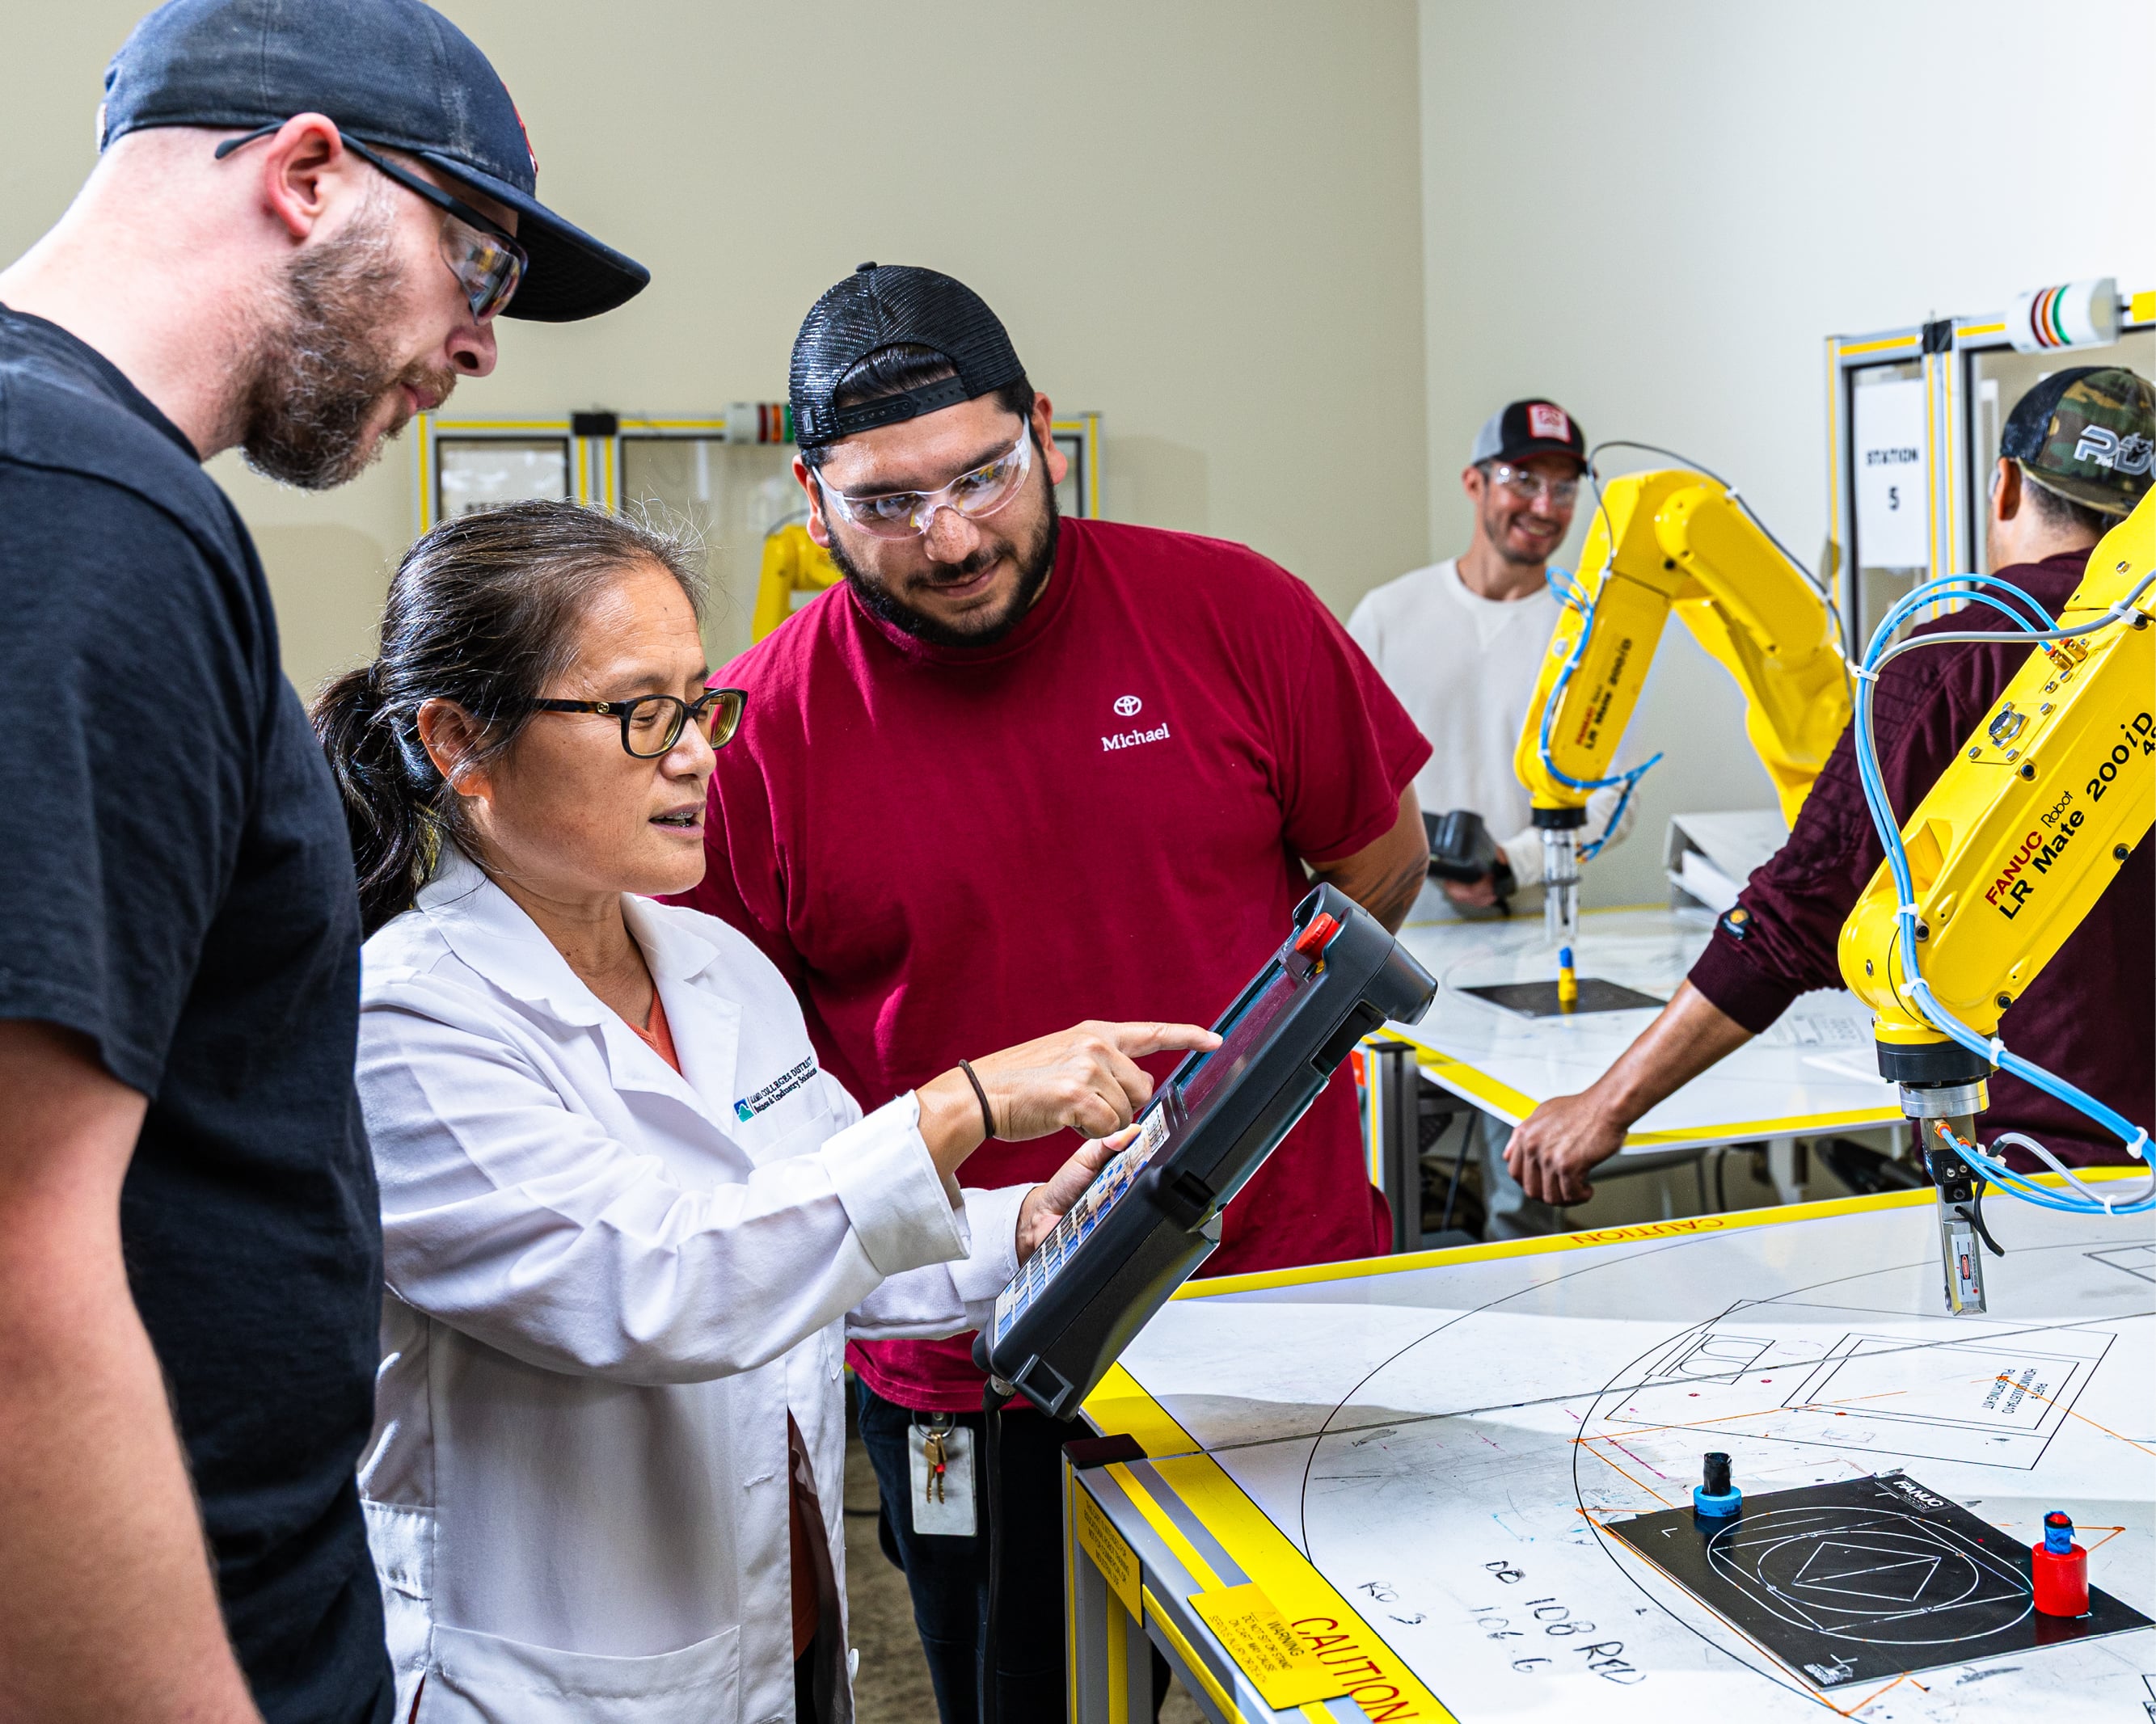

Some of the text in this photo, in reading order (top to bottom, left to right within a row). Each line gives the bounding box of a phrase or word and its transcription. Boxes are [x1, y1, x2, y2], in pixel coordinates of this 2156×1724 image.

[1867, 448, 1919, 466] STATION
[1888, 487, 1901, 511] 5
[1101, 723, 1170, 751] Michael
[1998, 712, 2154, 921] LR Mate 200iD
[1985, 790, 2074, 906] FANUC Robot
[761, 1073, 792, 1097] COLLEGES
[773, 1081, 801, 1102] Industry
[1569, 1218, 1724, 1244] CAUTION
[1893, 1481, 1944, 1507] FANUC
[1267, 1621, 1304, 1657] WARNING
[1291, 1617, 1420, 1724] CAUTION
